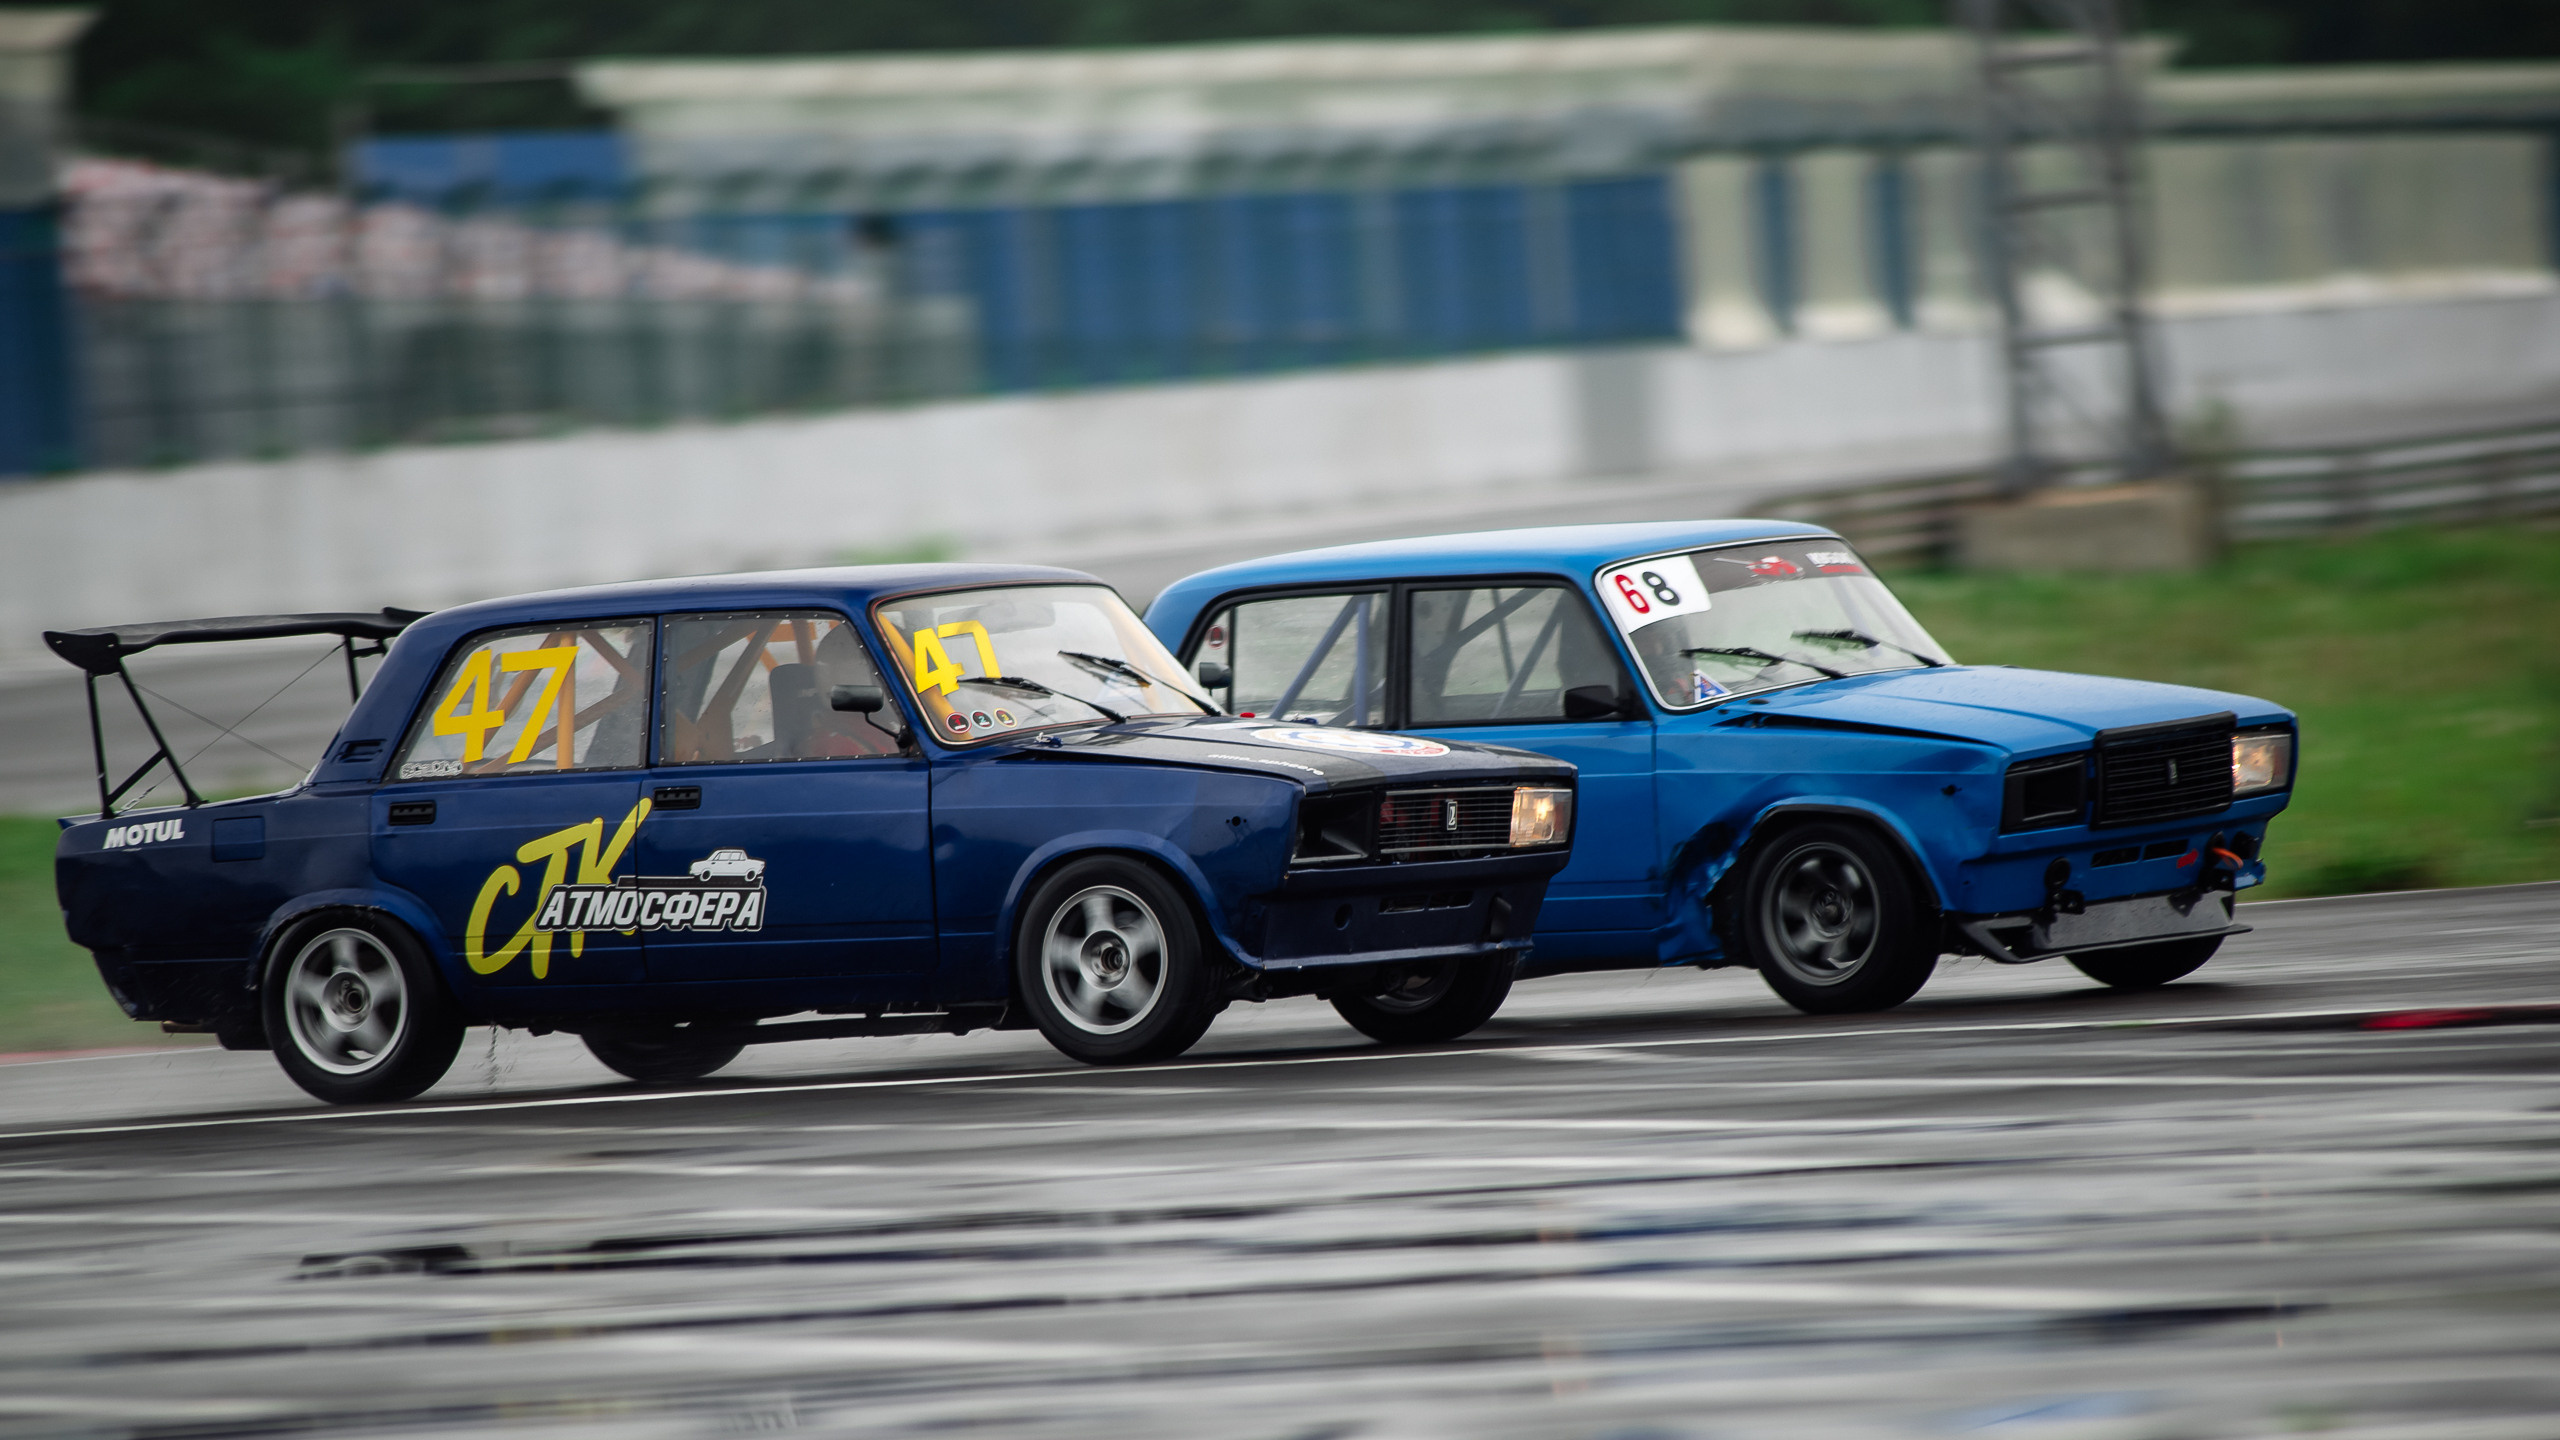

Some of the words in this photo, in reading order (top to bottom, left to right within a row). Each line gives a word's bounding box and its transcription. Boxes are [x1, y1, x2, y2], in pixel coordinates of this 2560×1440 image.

[1614, 571, 1680, 614] 68
[914, 620, 1002, 697] 47
[433, 646, 580, 764] 47
[102, 818, 185, 850] MOTUL
[538, 890, 763, 927] АТМОСФЕРА
